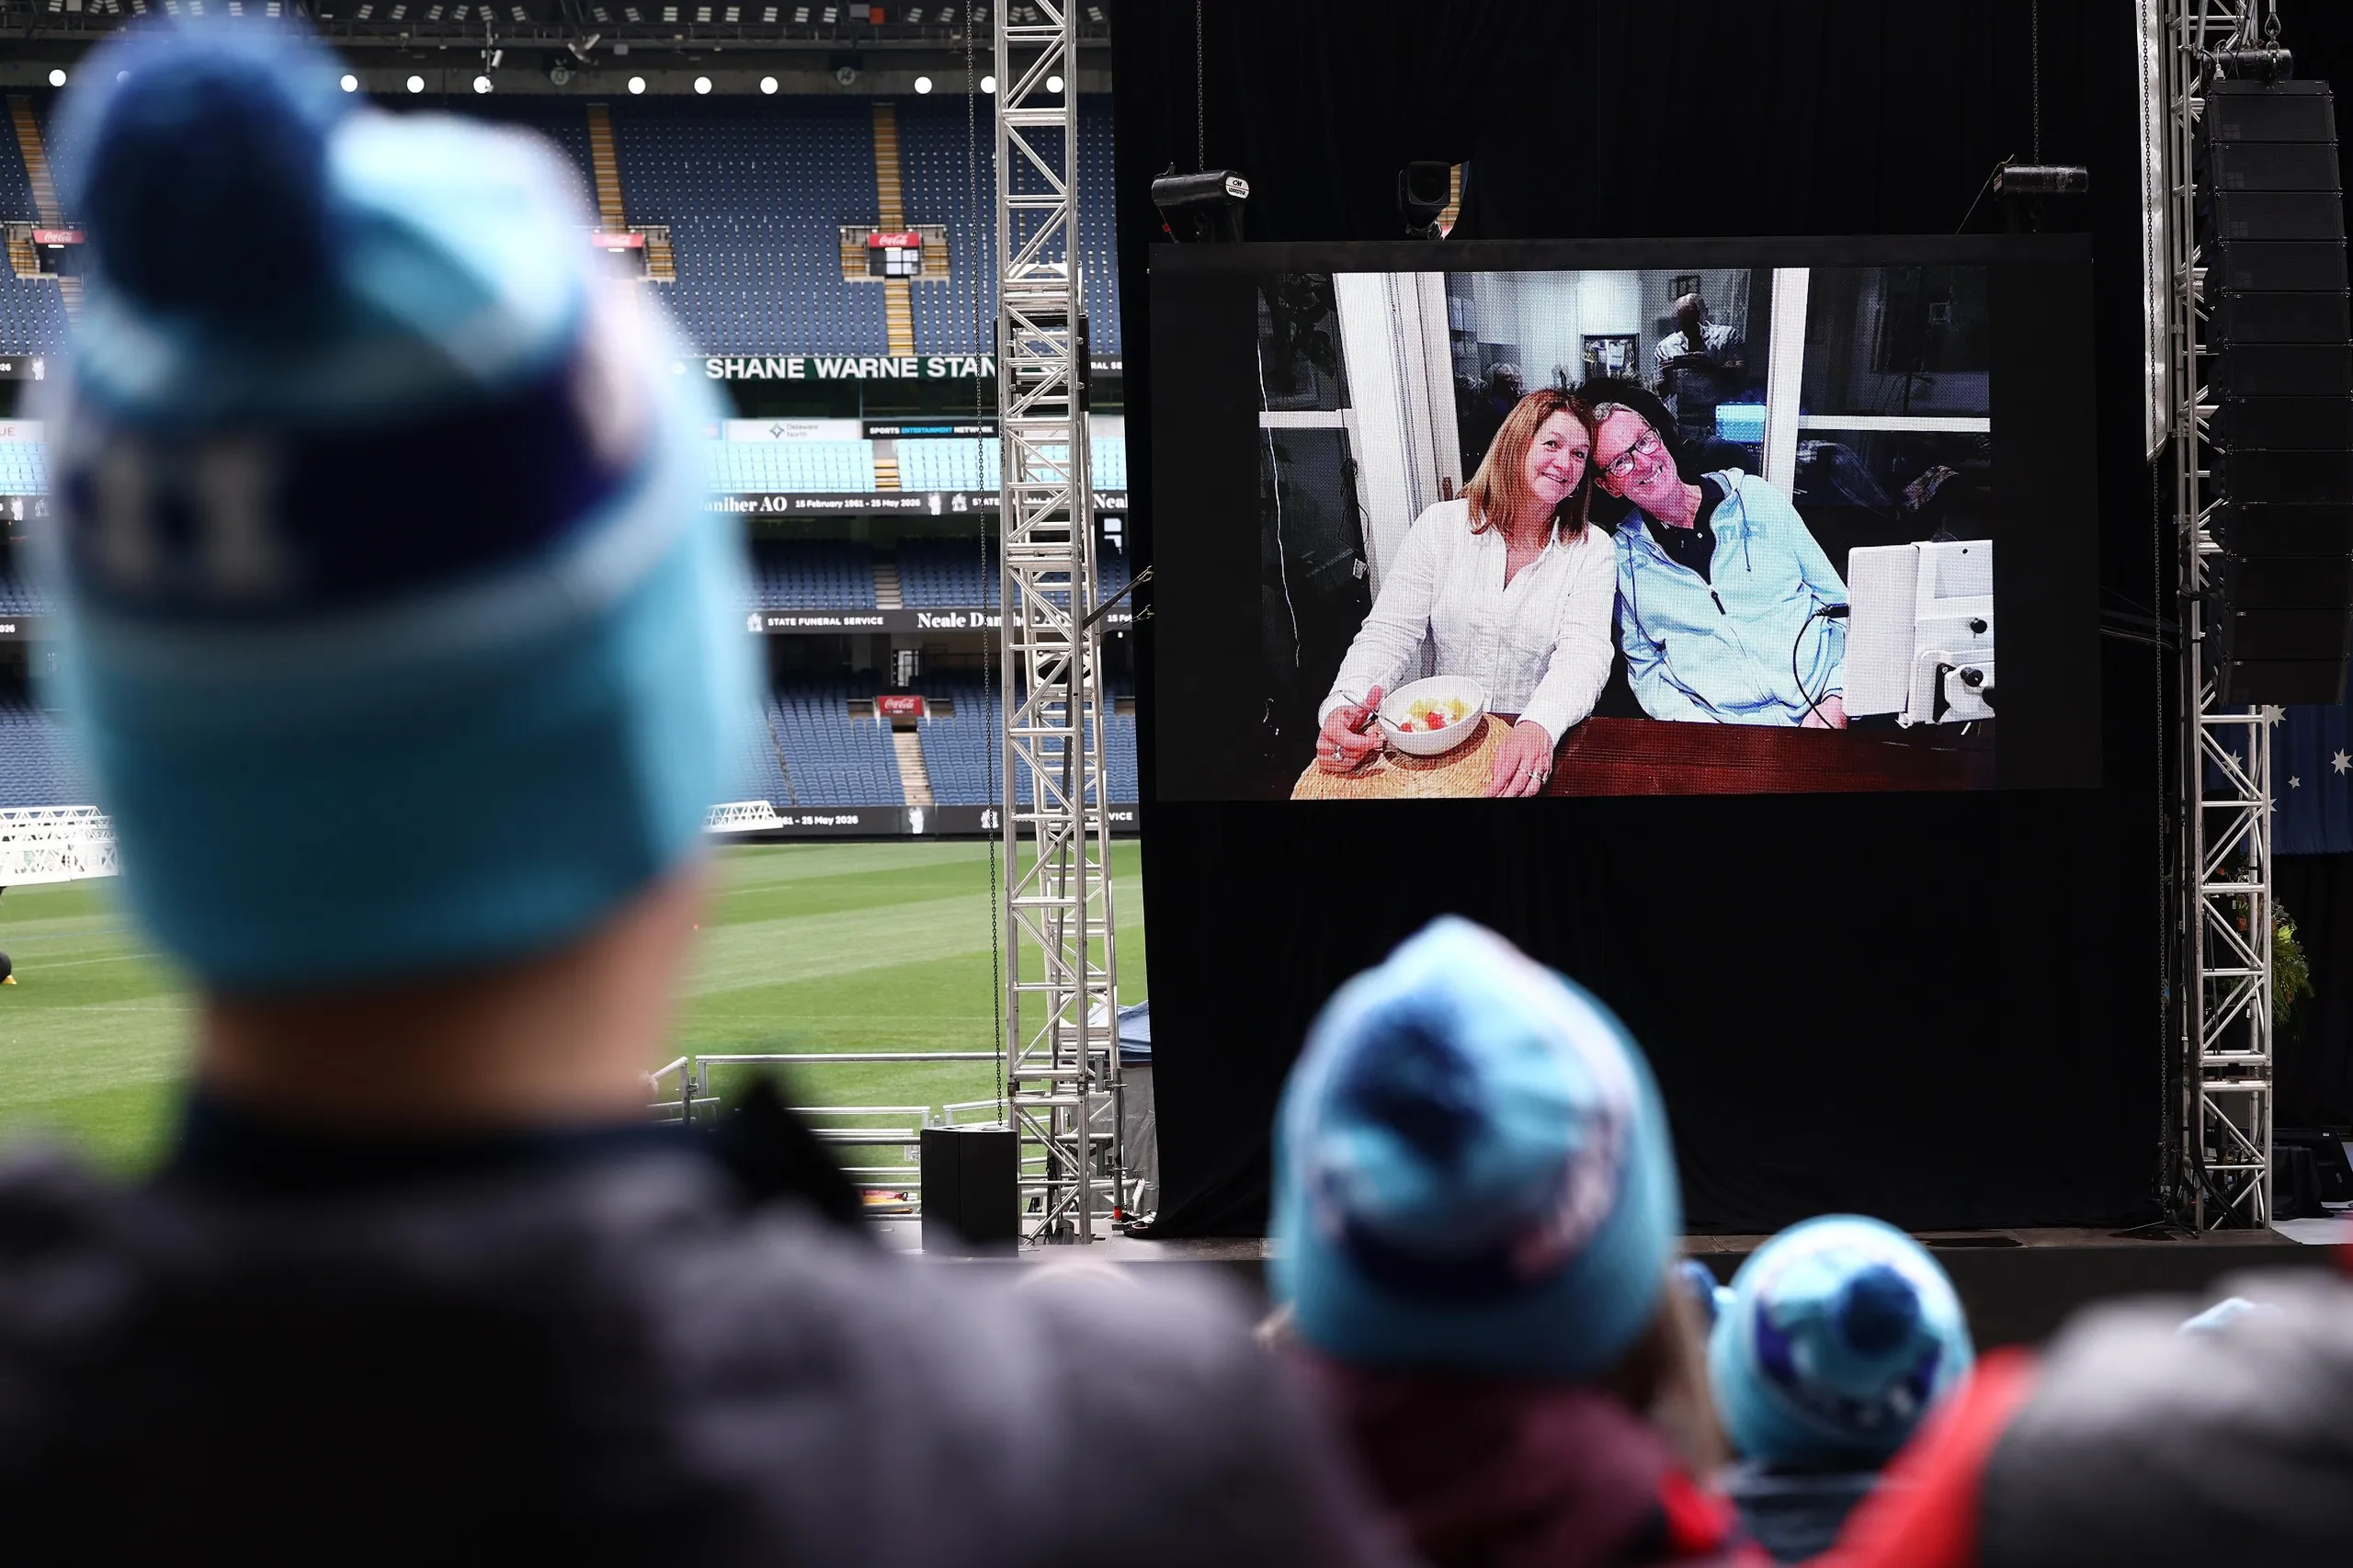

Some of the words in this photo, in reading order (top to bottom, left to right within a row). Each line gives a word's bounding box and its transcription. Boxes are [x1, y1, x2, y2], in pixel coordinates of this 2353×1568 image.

[879, 234, 909, 246] Coca-Cola
[705, 358, 805, 379] SHANE
[813, 358, 919, 379] WARNE
[759, 496, 788, 512] AO
[795, 499, 806, 507] 15
[806, 499, 844, 509] February
[844, 499, 864, 507] 1961
[881, 499, 900, 508] May
[767, 618, 796, 626] STATE
[798, 617, 842, 626] FUNERAL
[843, 616, 883, 625] SERVICE
[916, 611, 967, 628] Neale
[1107, 614, 1118, 622] 15
[884, 698, 915, 710] Coca-Cola
[801, 815, 813, 824] 25
[813, 815, 835, 825] May
[835, 814, 859, 824] 2026
